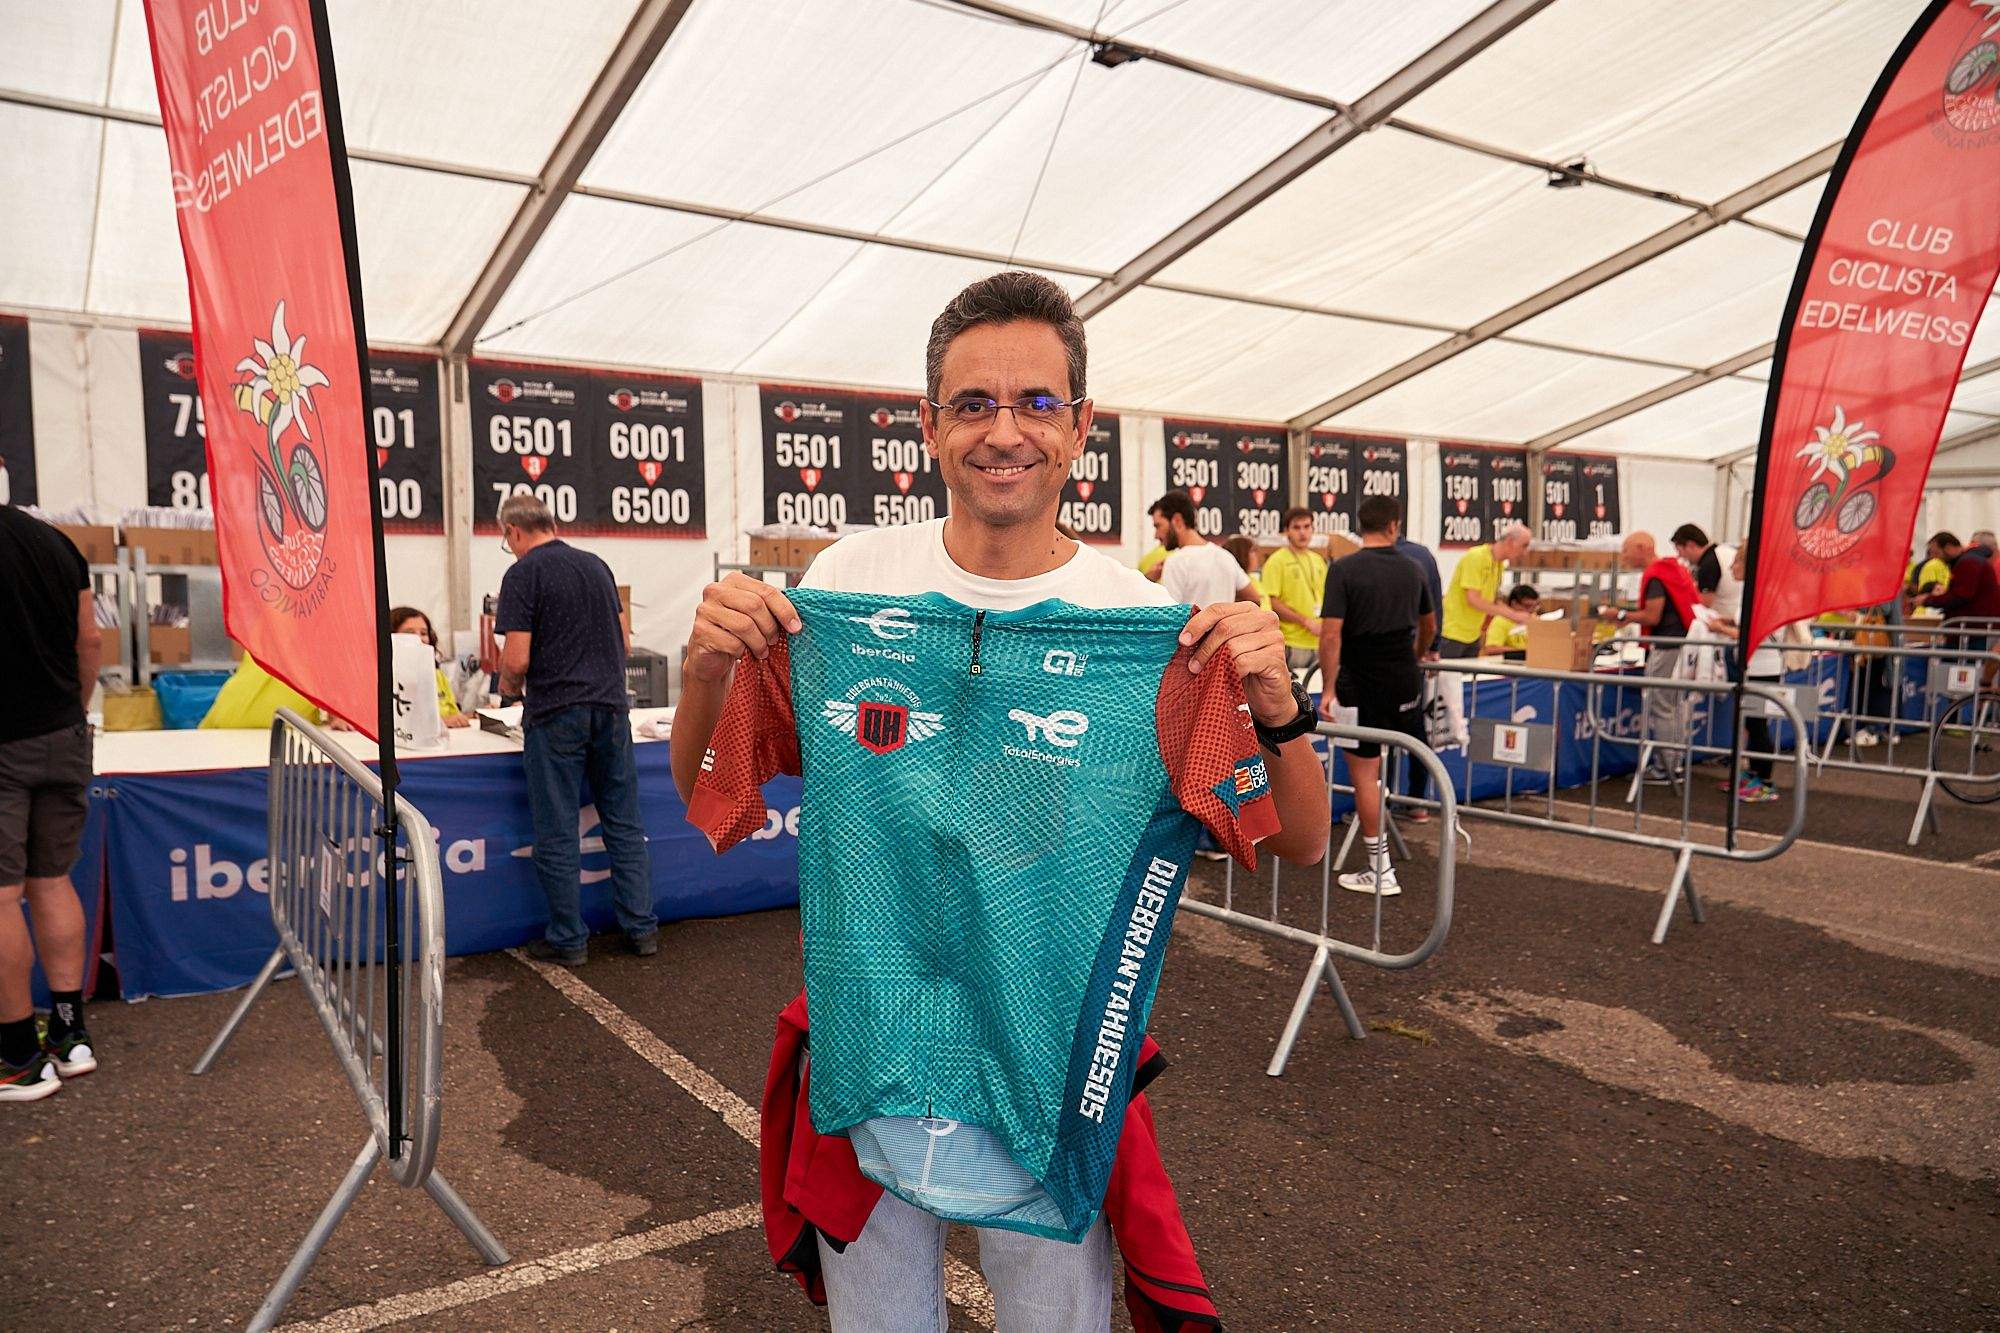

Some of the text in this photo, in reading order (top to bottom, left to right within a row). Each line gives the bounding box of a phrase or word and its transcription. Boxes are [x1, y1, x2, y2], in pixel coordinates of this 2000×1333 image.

[1866, 218, 1953, 255] CLUB
[1828, 258, 1957, 303] CICLISTA
[1800, 300, 1972, 347] EDELWEISS
[372, 406, 415, 449] 01
[489, 414, 572, 457] 6501
[609, 421, 685, 462] 6001
[776, 432, 841, 469] 5501
[872, 438, 931, 473] 5001
[1072, 451, 1109, 482] 001
[1172, 457, 1219, 488] 3501
[1237, 461, 1279, 491] 3001
[1309, 466, 1348, 495] 2501
[1363, 469, 1400, 497] 2001
[1445, 475, 1479, 501] 1501
[379, 478, 422, 519] 00
[611, 486, 690, 524] 6500
[1491, 478, 1523, 502] 1001
[1546, 481, 1570, 505] 501
[1595, 484, 1604, 505] 1
[777, 492, 846, 528] 6000
[874, 494, 935, 526] 5500
[1195, 507, 1222, 535] 00
[1238, 508, 1280, 537] 3500
[1444, 516, 1481, 541] 2000
[845, 676, 923, 711] QUEBRANTAHUESOS
[1003, 744, 1081, 767] TotalEnergies
[1079, 856, 1179, 1124] QUEBRANTAHUESOS
